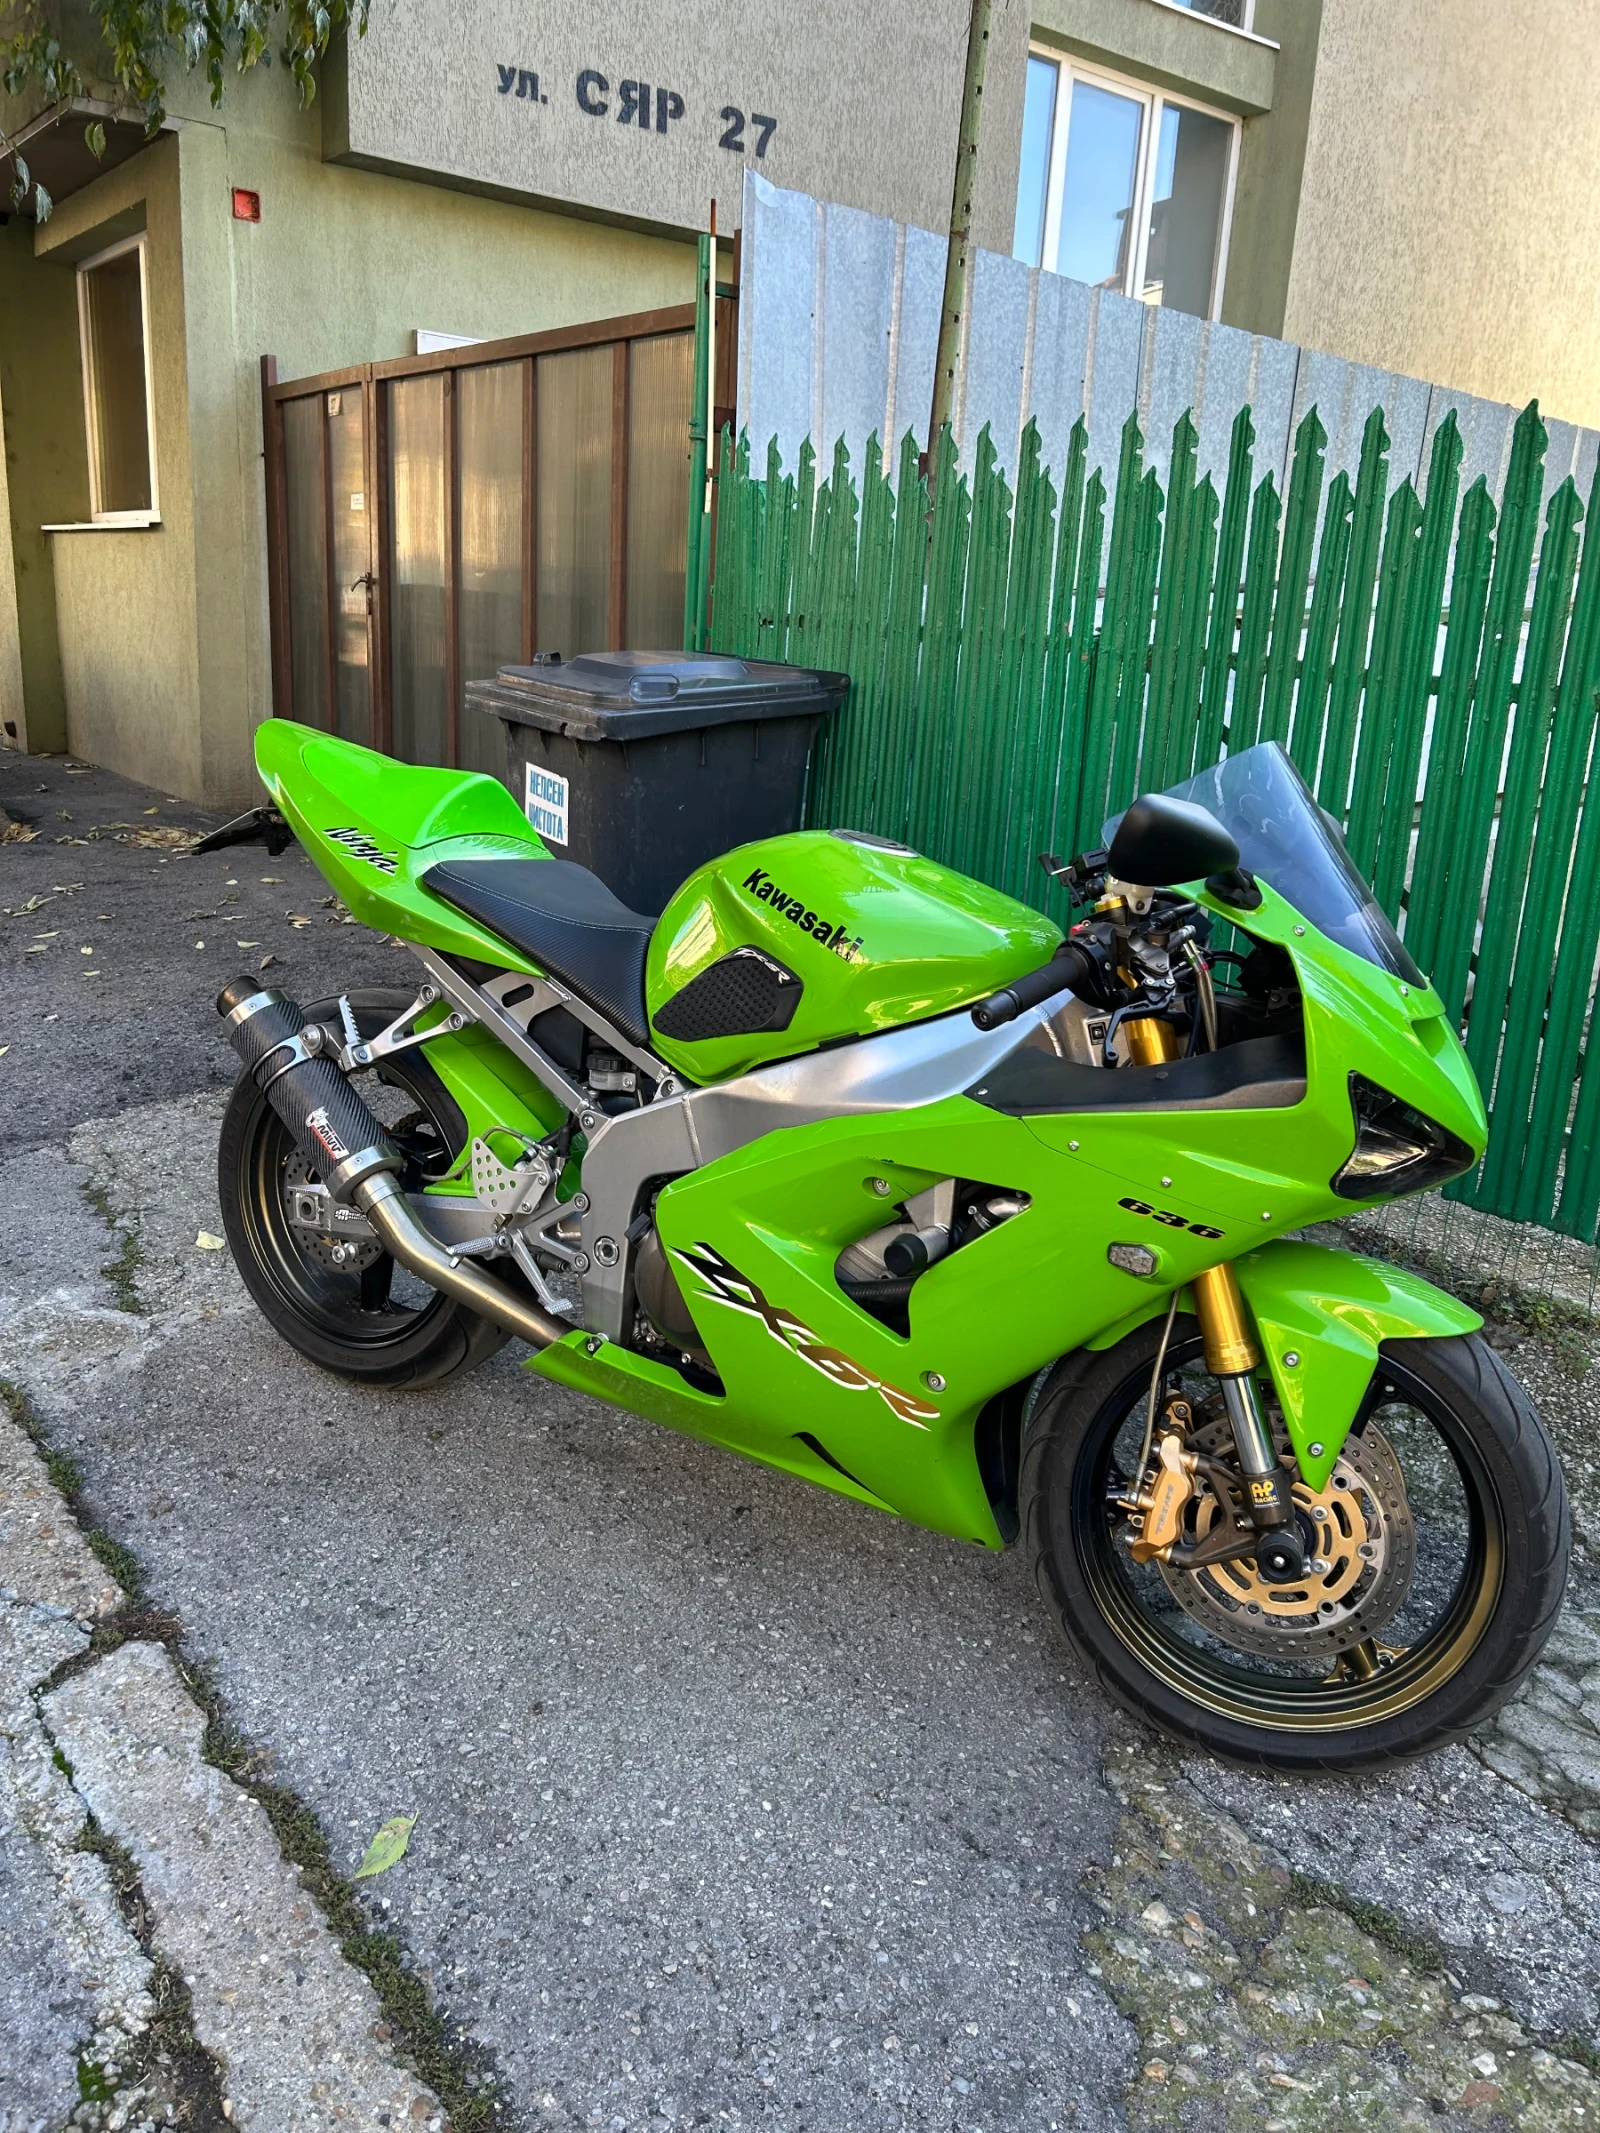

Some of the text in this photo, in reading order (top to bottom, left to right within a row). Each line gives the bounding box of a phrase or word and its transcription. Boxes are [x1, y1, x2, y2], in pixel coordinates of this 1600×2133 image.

[496, 64, 777, 158] ул. СЯР 27
[322, 827, 399, 876] Ninja
[741, 867, 865, 963] Kawasaki
[1117, 1197, 1226, 1239] 636
